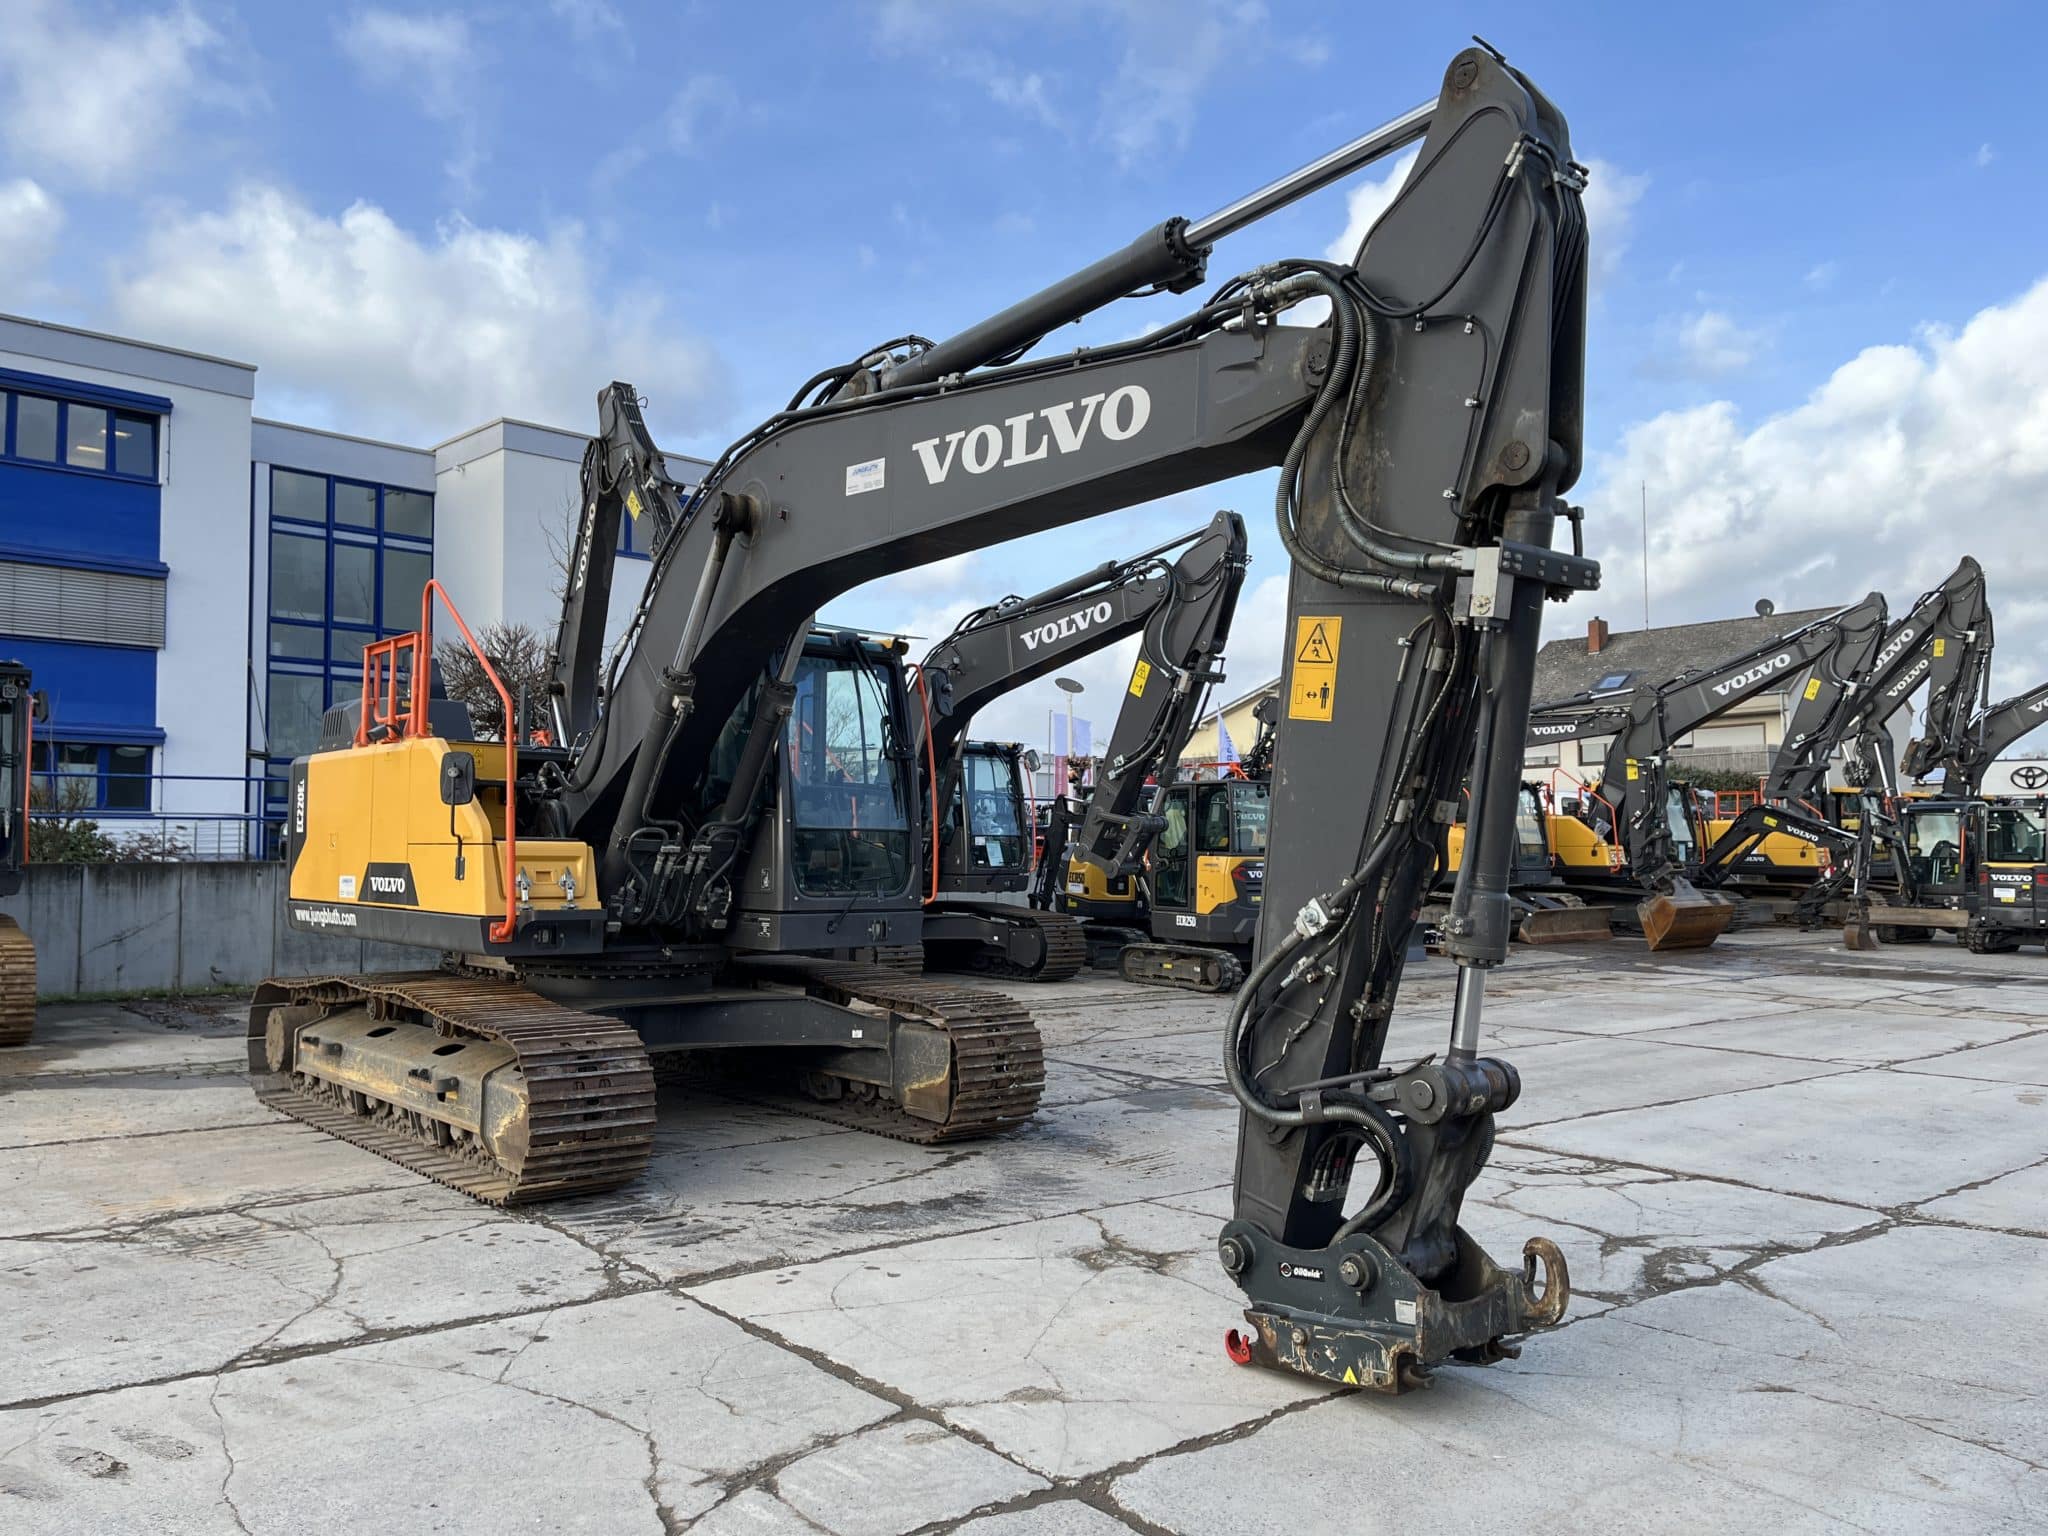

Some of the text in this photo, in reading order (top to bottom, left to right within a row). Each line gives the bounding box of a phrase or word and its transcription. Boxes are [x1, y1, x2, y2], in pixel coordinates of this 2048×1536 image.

[912, 384, 1151, 485] VOLVO
[576, 502, 596, 591] VOLVO
[1020, 601, 1112, 651] VOLVO
[1712, 652, 1791, 697] VOLVO
[1886, 659, 1929, 697] VOLVO
[1532, 724, 1577, 736] VOLVO
[1786, 825, 1820, 842] VOLVO
[370, 877, 406, 893] VOLVO
[1990, 874, 2033, 882] VOLVO
[294, 907, 357, 927] www.jungbluth.com
